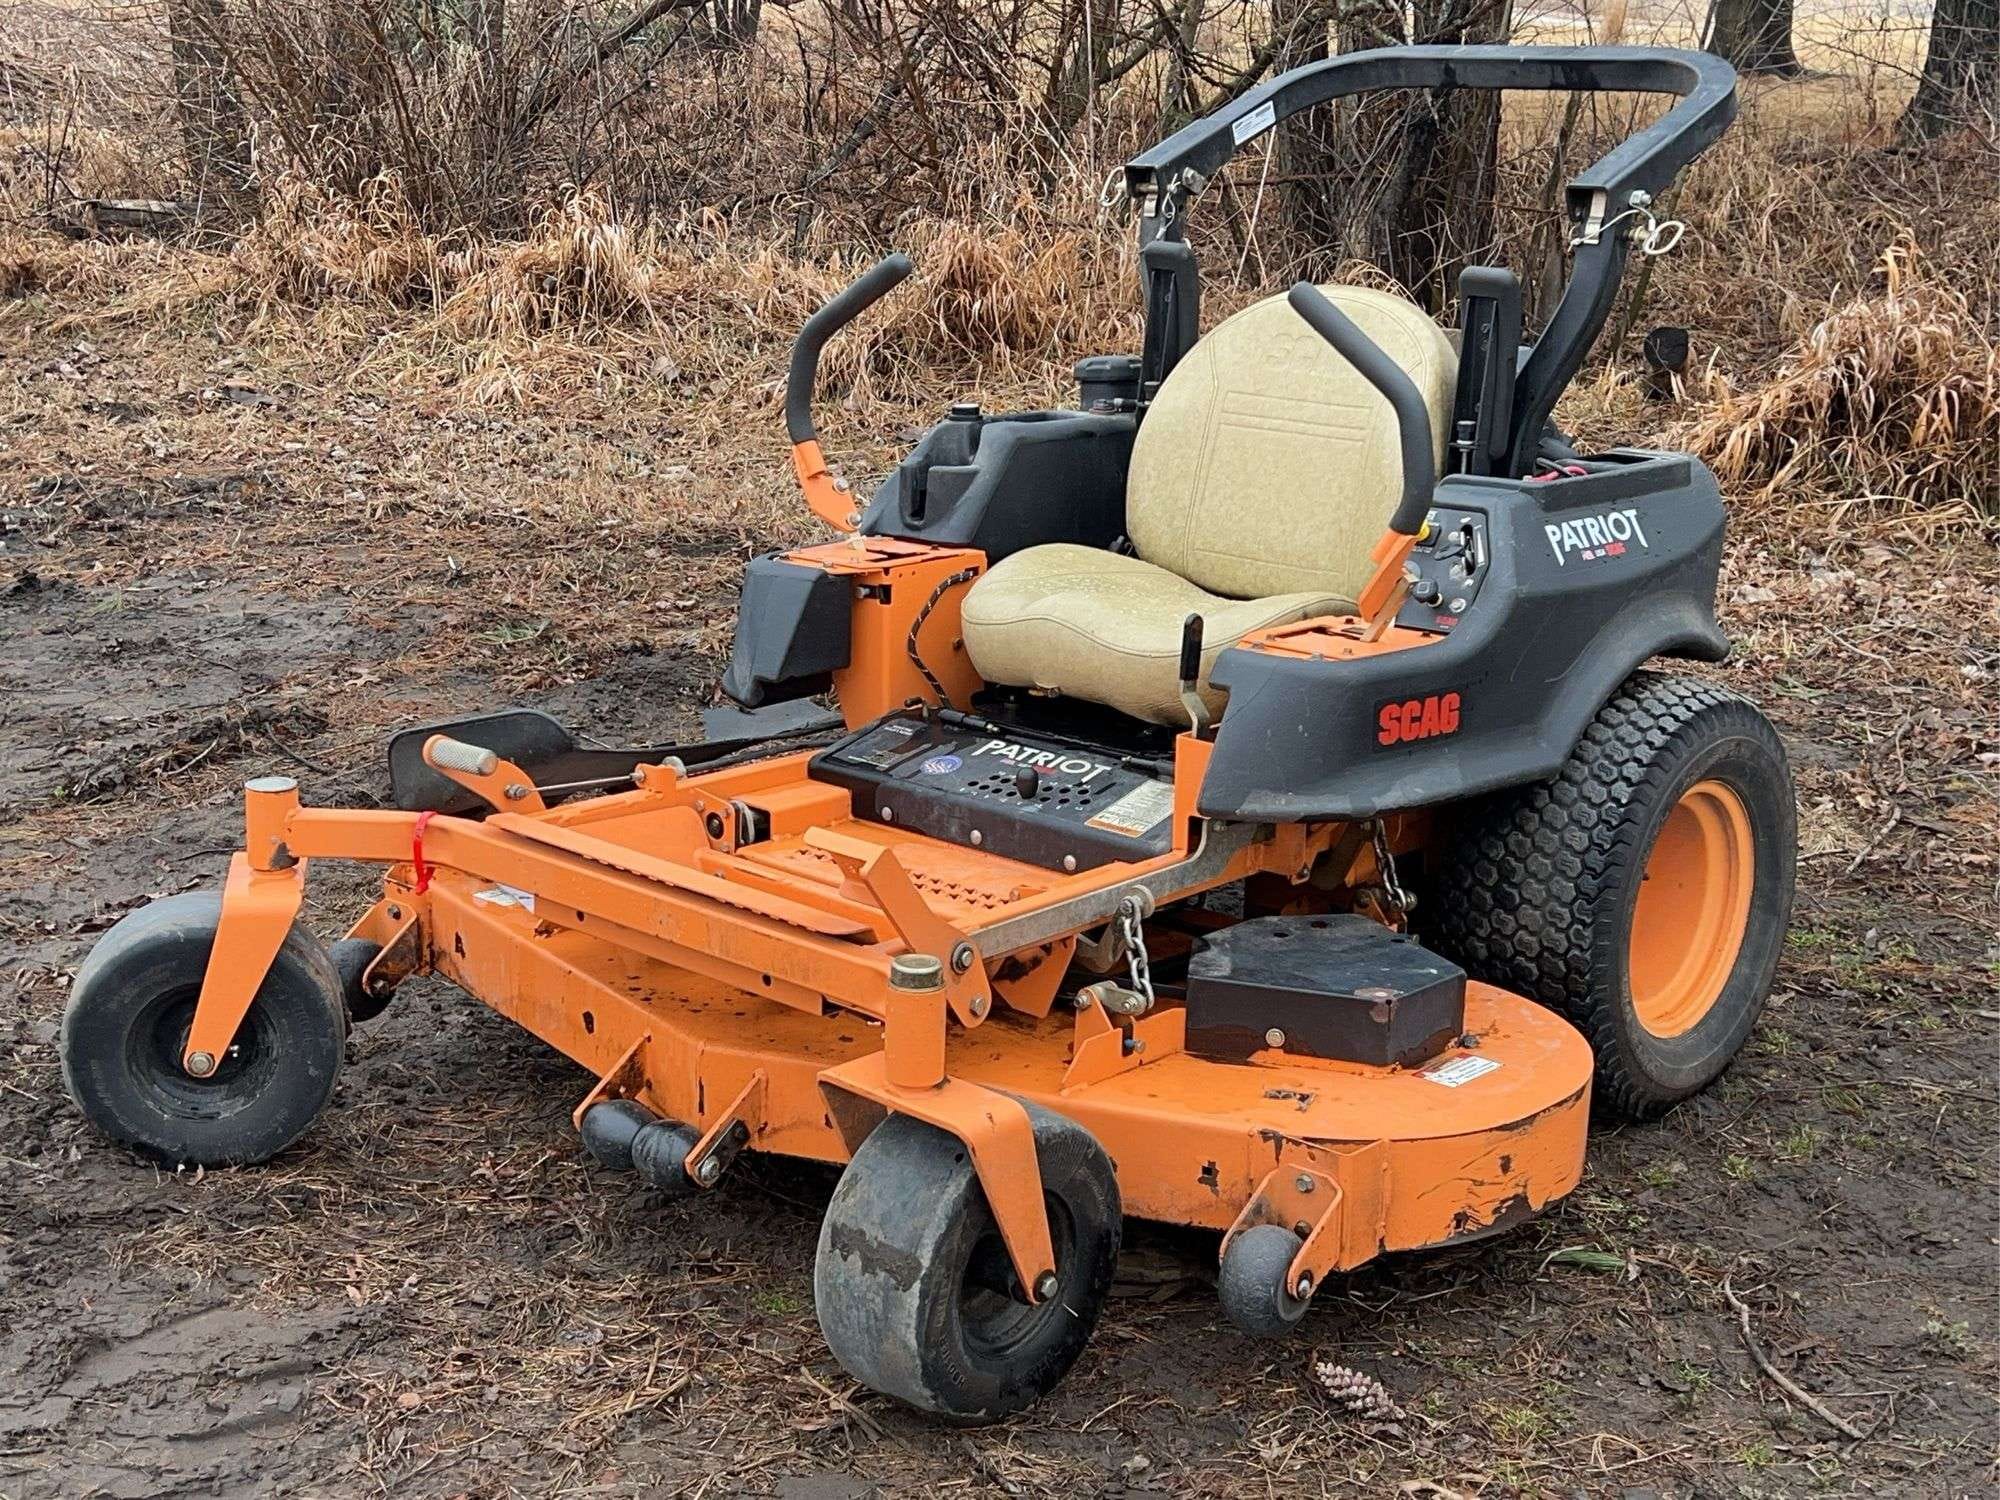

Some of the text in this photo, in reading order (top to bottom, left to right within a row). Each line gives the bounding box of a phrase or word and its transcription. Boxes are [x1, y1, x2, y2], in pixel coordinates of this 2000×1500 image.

[1544, 509, 1648, 567] PATRIOT
[1378, 692, 1461, 746] SCAG
[971, 739, 1112, 784] PATRIOT
